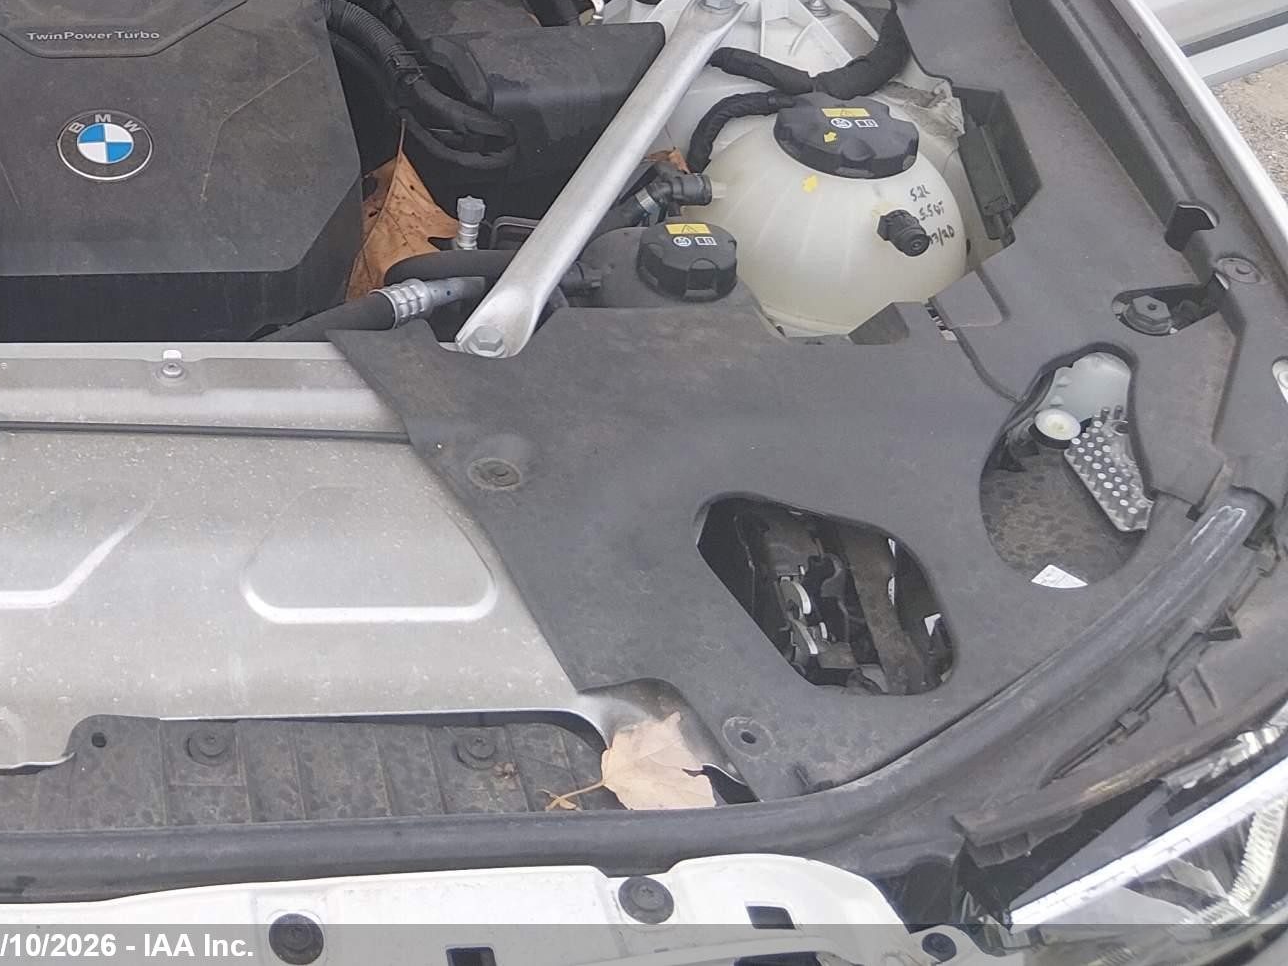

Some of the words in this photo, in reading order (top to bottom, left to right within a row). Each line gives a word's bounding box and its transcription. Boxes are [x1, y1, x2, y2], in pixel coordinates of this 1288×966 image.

[26, 30, 112, 42] TwinPower
[114, 29, 161, 40] Turbo
[67, 113, 144, 134] BMW
